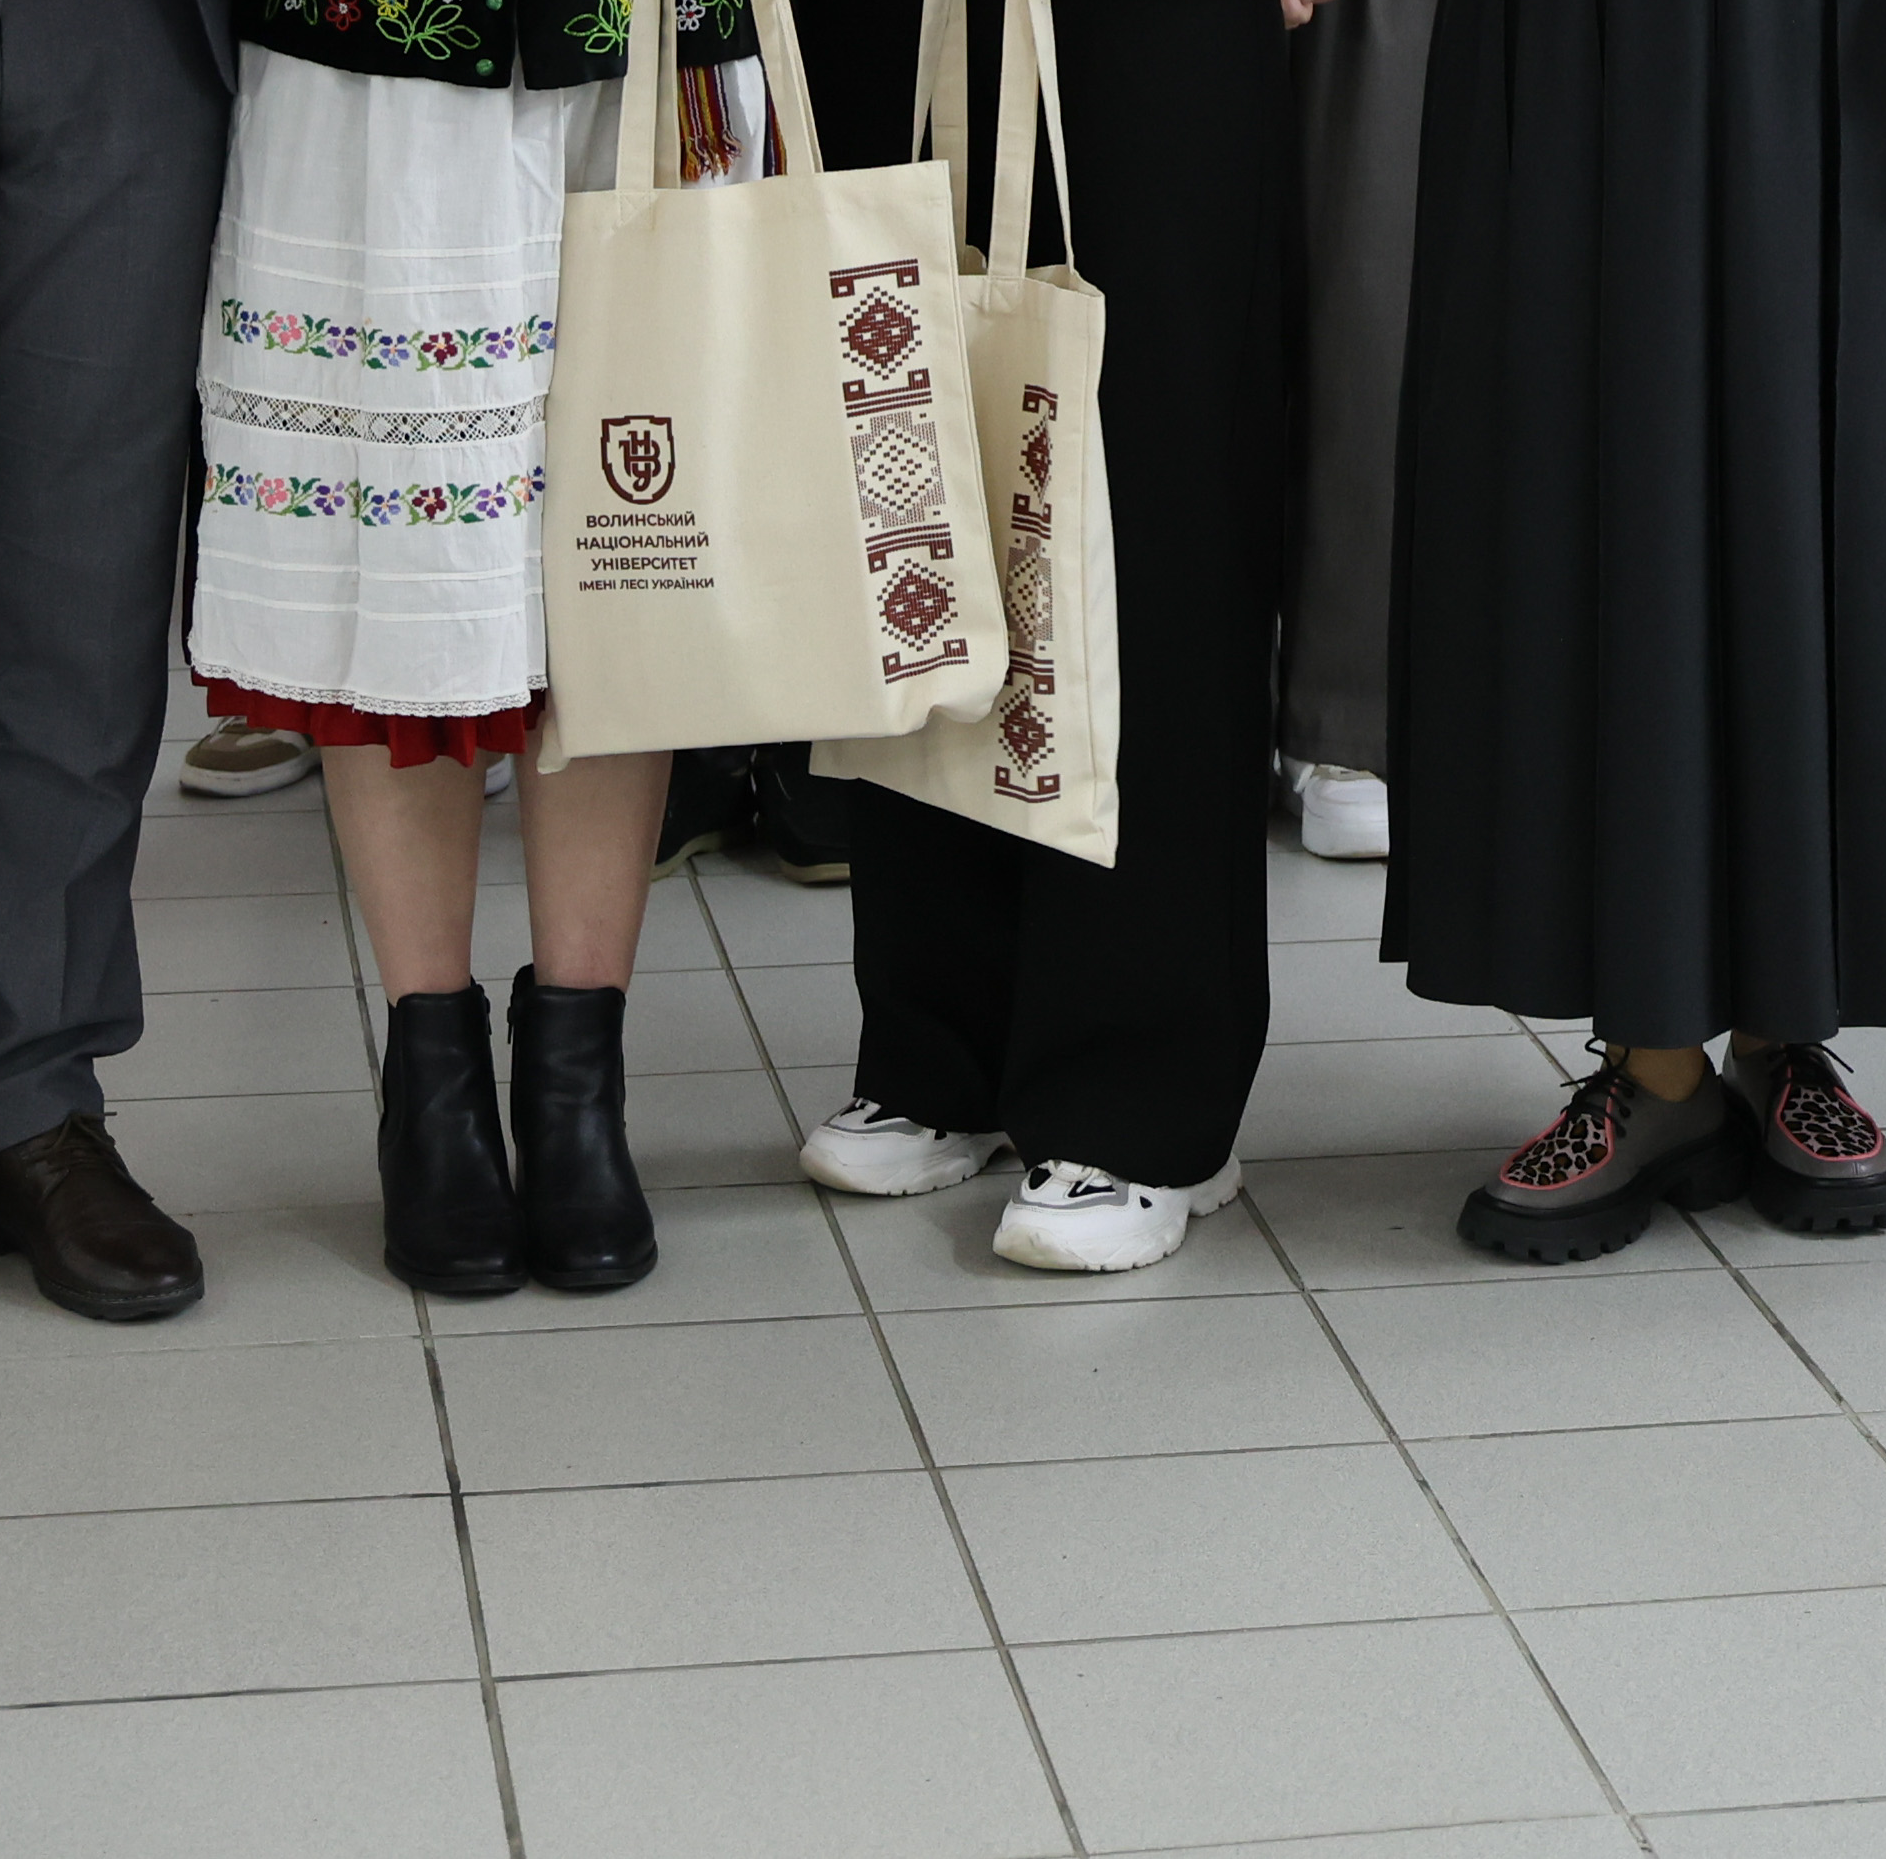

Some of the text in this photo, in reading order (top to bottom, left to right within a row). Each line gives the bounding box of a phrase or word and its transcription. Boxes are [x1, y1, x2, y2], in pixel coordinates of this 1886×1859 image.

[586, 510, 696, 528] ВОЛИНСЬКИЙ
[576, 531, 709, 551] НАЦІОНАЛЬНИЙ
[591, 556, 698, 571] УНІВЕРСИТЕТ
[579, 576, 715, 591] ІМЕНІ ЛЕСІ УКРАЇНКИ
